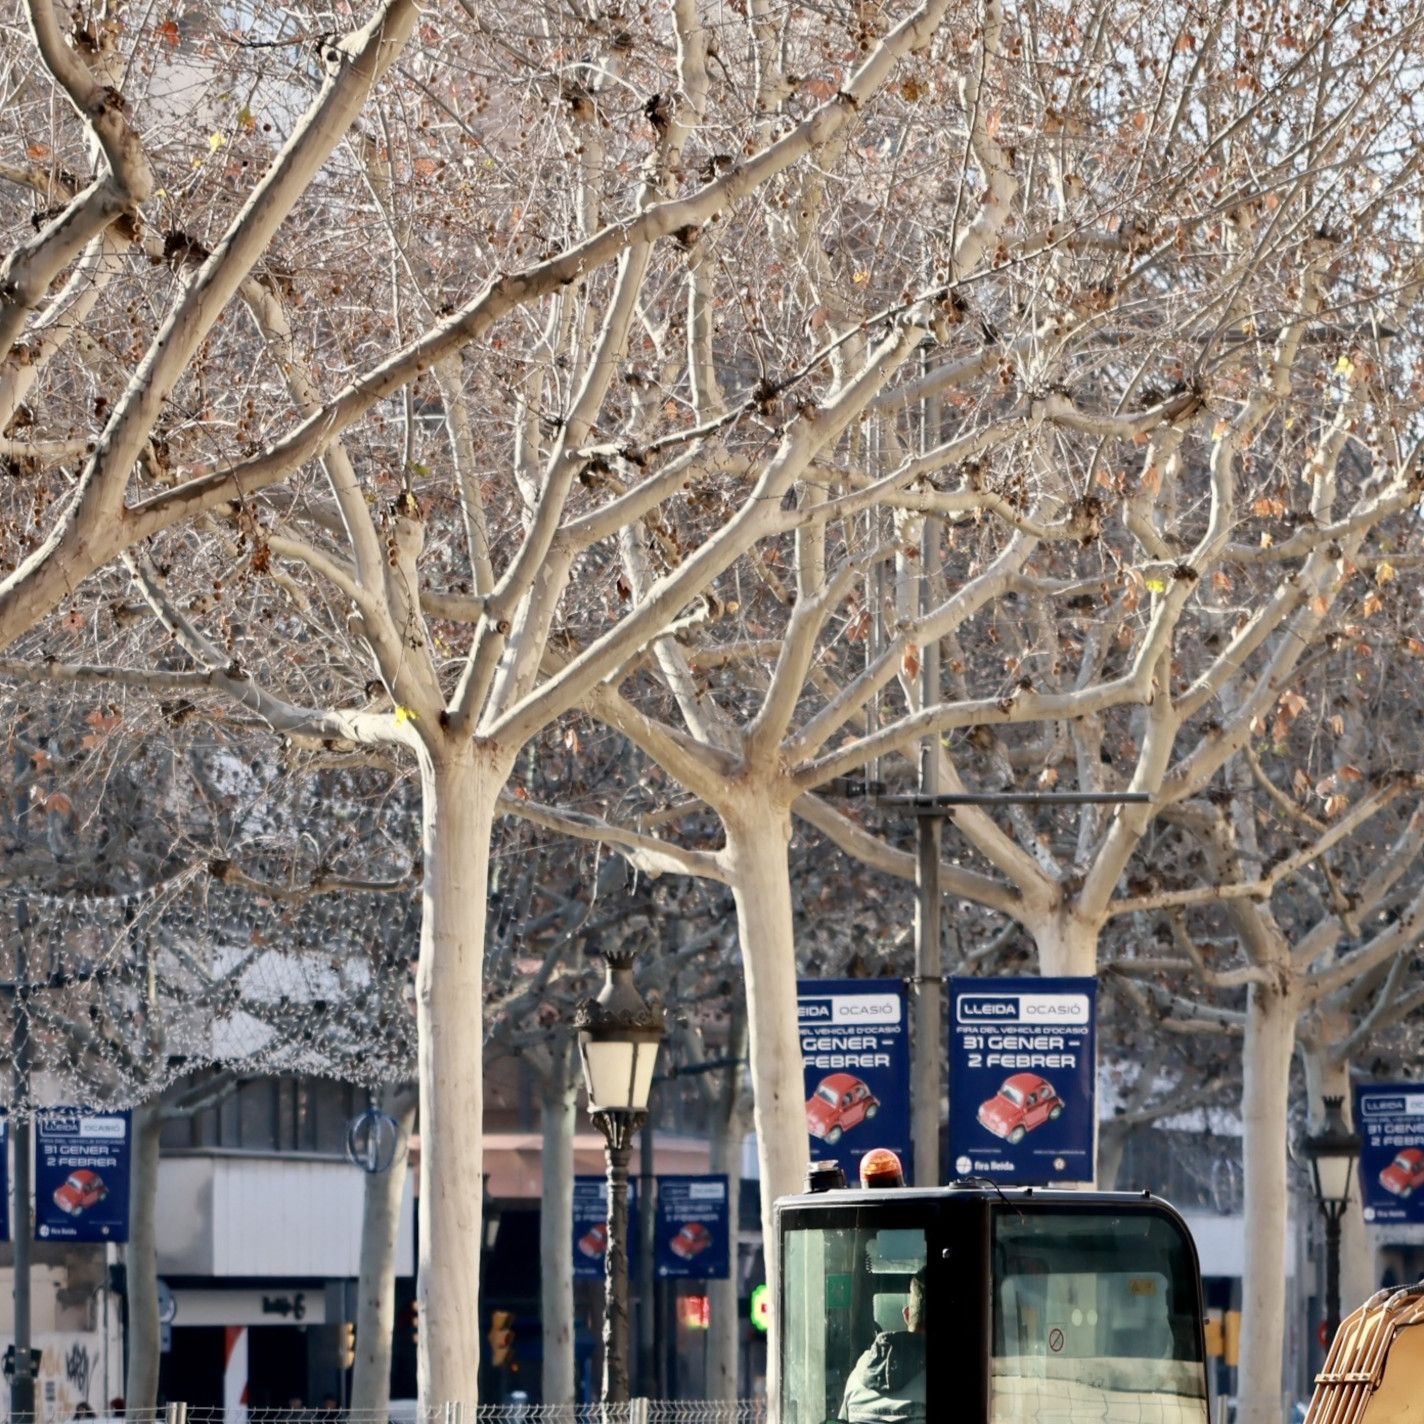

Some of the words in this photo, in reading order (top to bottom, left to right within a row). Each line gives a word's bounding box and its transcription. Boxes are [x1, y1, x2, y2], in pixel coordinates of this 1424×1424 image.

[798, 1006, 829, 1017] EIDA
[839, 1003, 892, 1016] OCASIÓ
[964, 1003, 1016, 1015] LLEIDA
[1026, 1003, 1081, 1015] OCASIÓ
[802, 1037, 877, 1051] GENER
[963, 1036, 984, 1050] 31
[988, 1036, 1064, 1050] GENER
[804, 1054, 890, 1069] FEBRER
[968, 1054, 982, 1068] 2
[986, 1054, 1076, 1068] FEBRER
[44, 1146, 57, 1154] 31
[60, 1146, 109, 1155] GENER
[47, 1157, 57, 1167] 2
[59, 1157, 117, 1167] FEBRER
